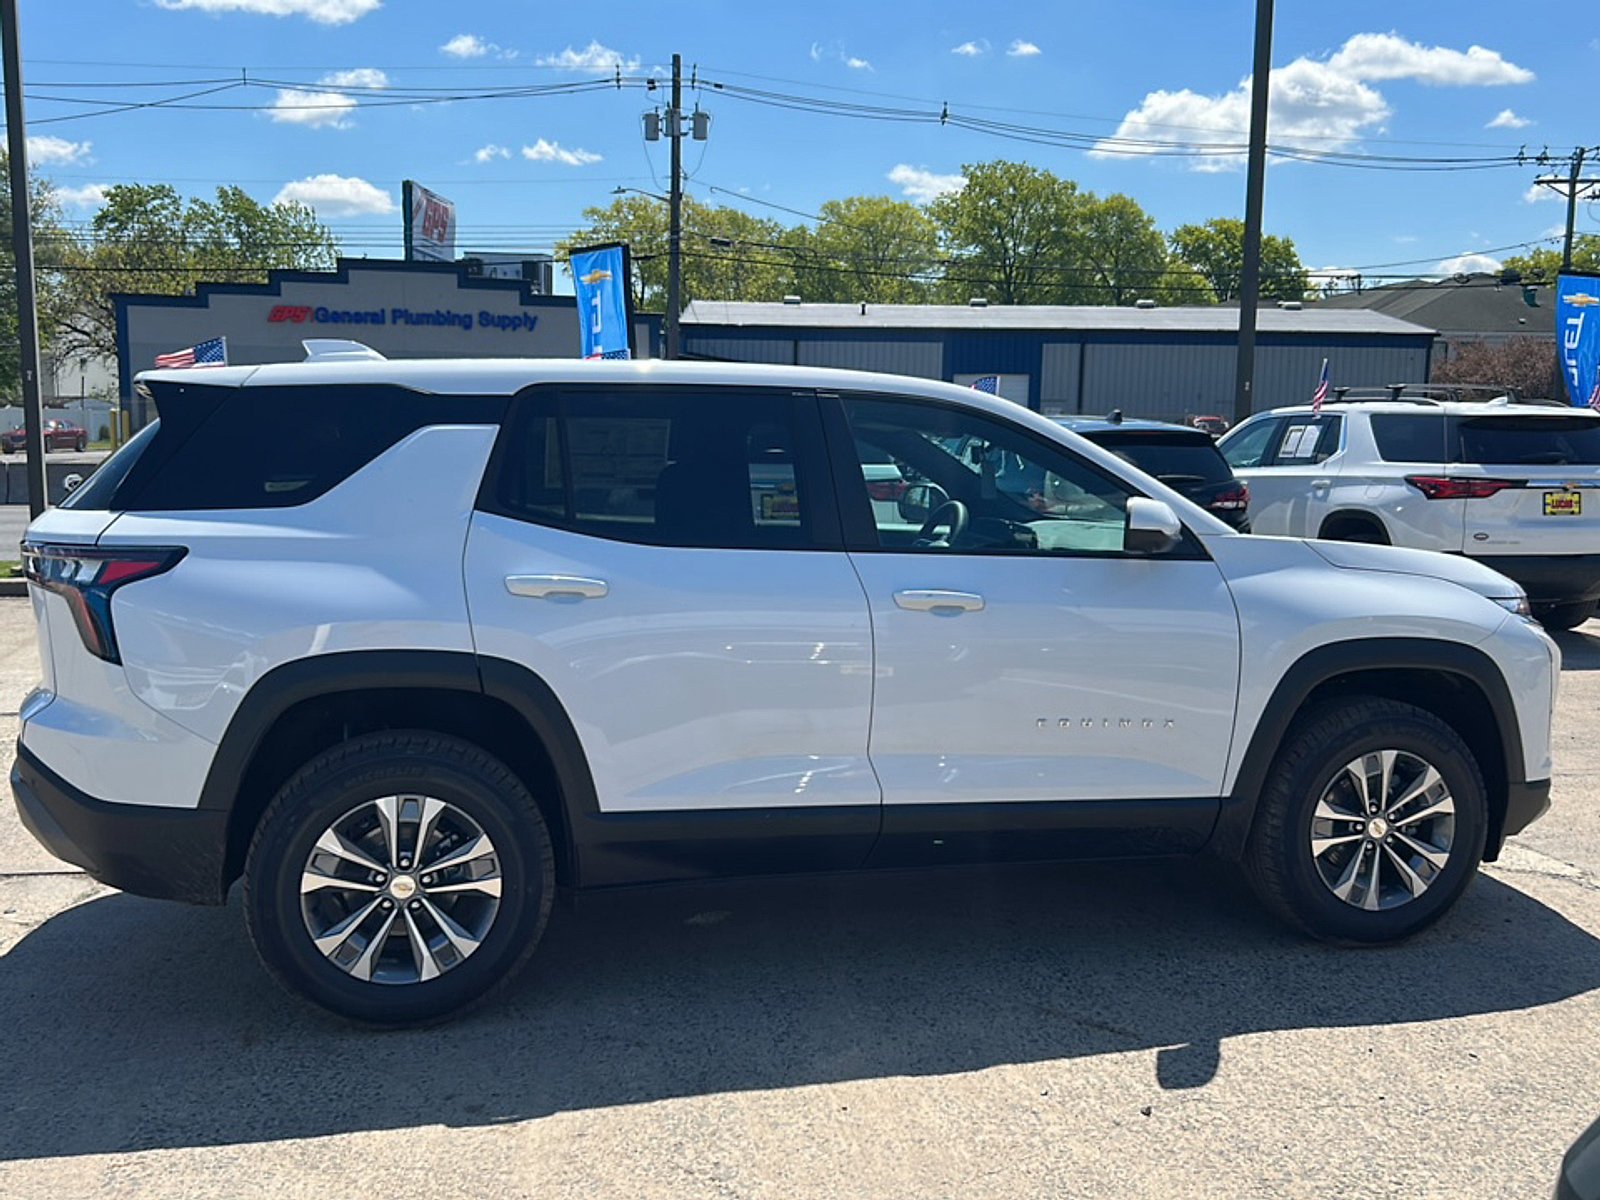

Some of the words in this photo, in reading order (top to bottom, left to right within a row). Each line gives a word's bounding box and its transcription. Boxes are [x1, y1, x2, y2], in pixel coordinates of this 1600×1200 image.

[422, 199, 449, 243] GPS
[315, 307, 385, 325] General
[391, 308, 473, 330] Plumbing
[478, 311, 538, 331] Supply
[1036, 717, 1176, 729] EQUINOX
